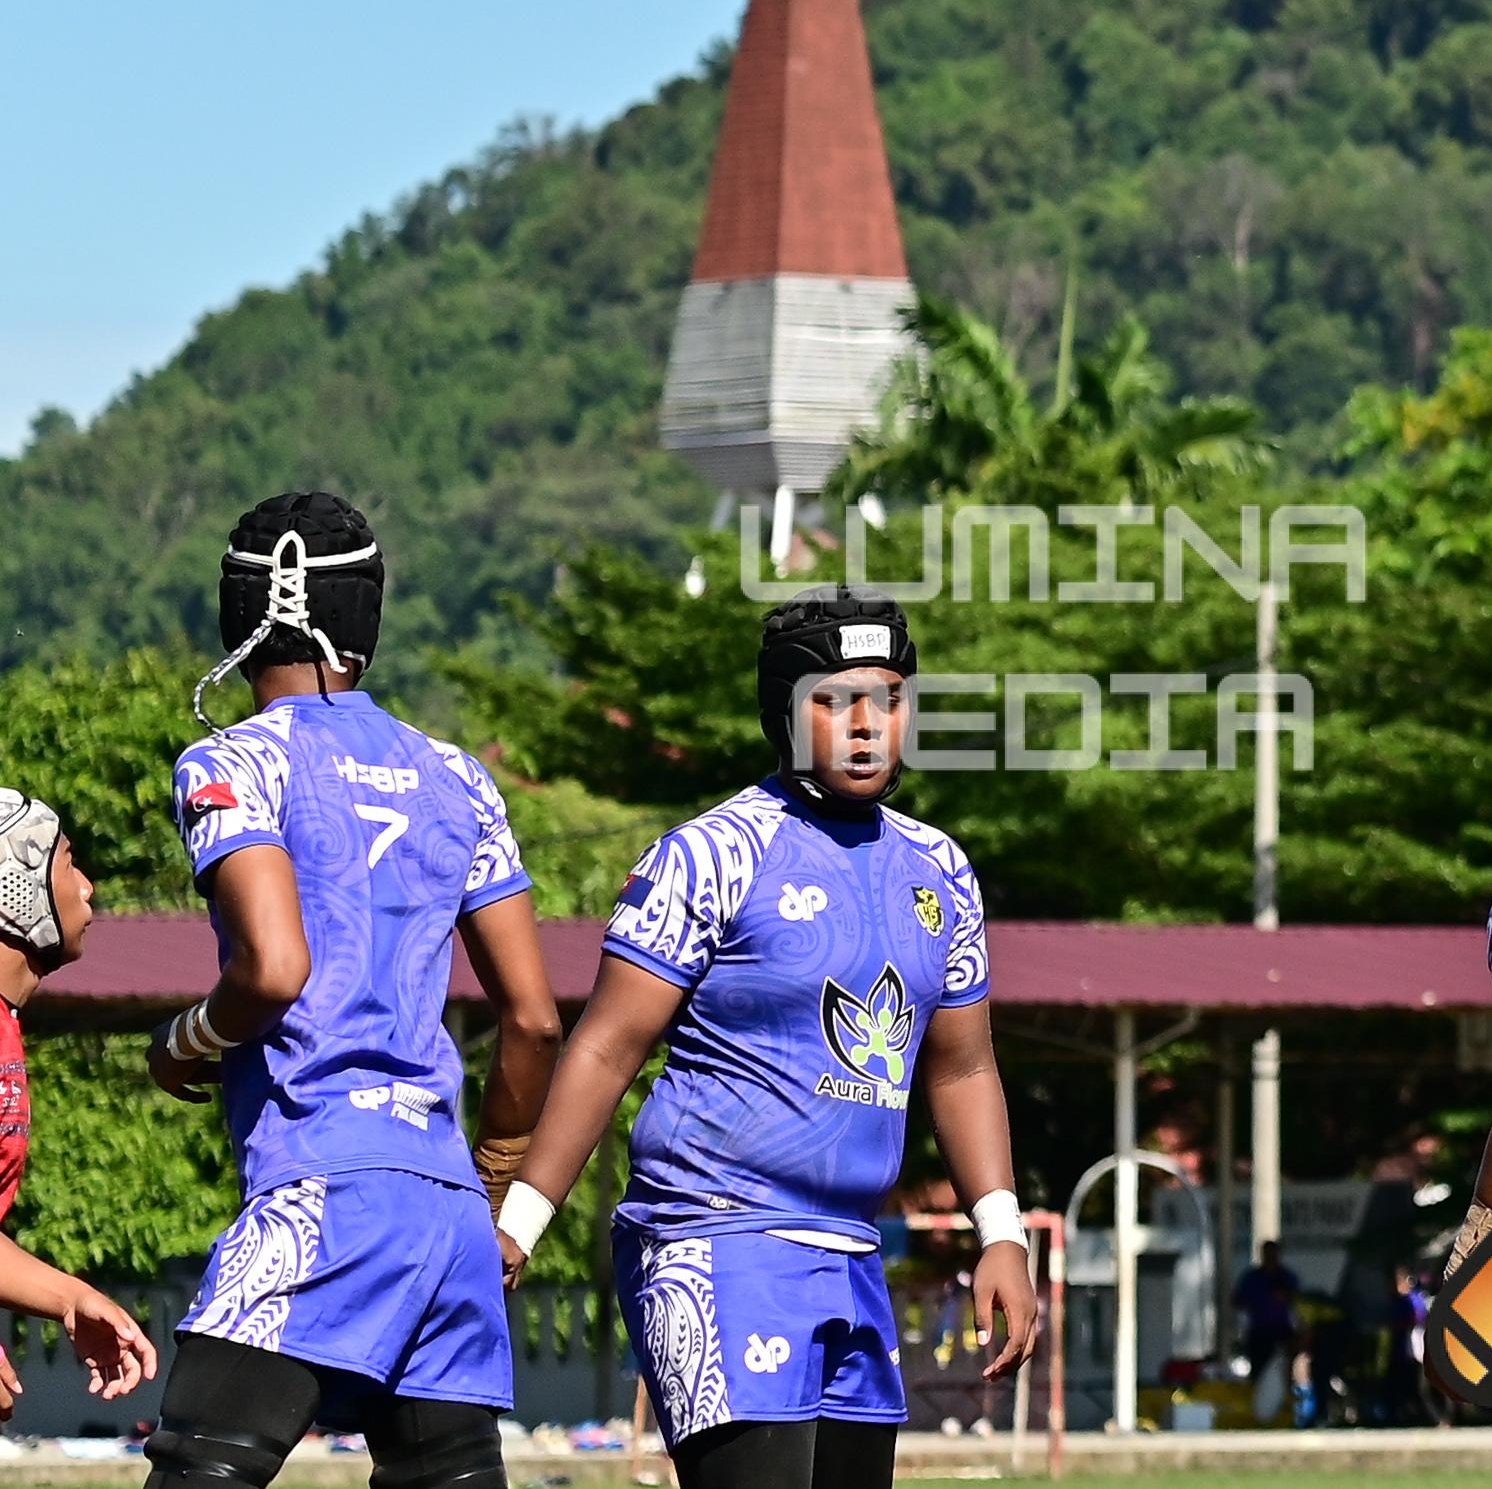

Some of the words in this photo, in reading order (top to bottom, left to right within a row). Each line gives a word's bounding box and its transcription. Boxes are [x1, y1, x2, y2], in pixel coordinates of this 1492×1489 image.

[847, 633, 886, 649] HSBP
[331, 755, 420, 795] HSBP
[353, 802, 410, 870] 7
[815, 1072, 873, 1105] Aura
